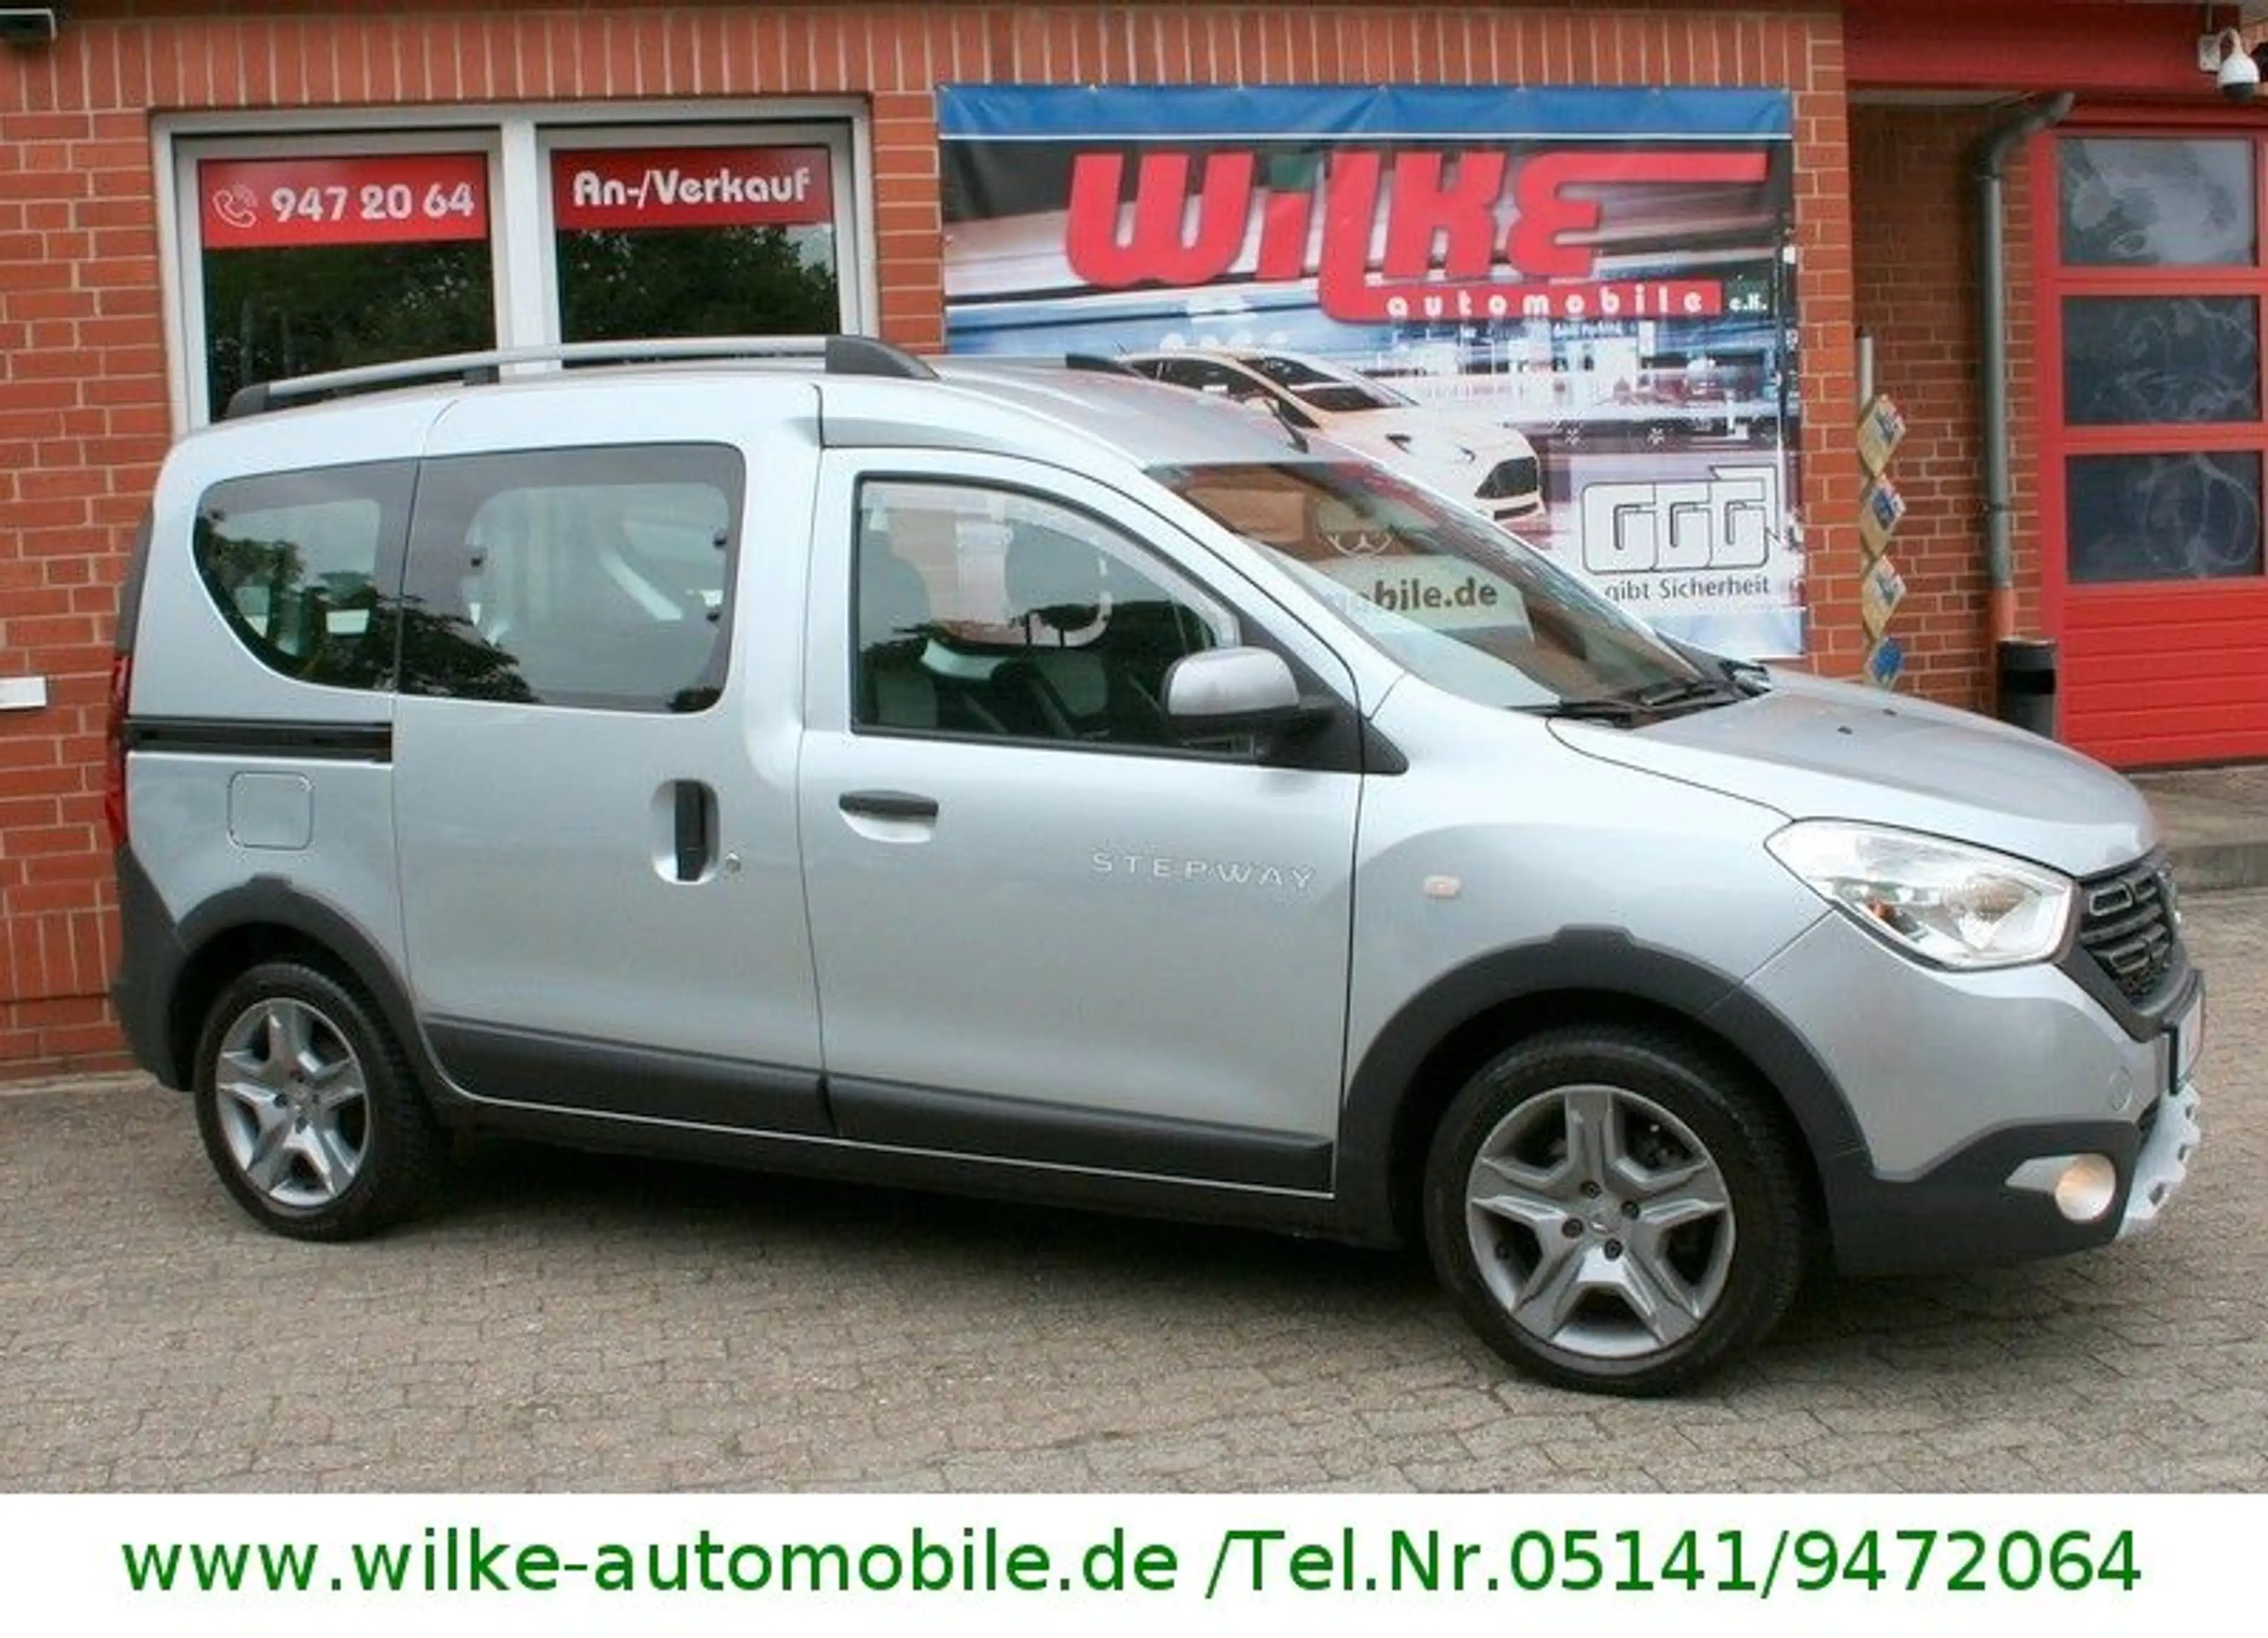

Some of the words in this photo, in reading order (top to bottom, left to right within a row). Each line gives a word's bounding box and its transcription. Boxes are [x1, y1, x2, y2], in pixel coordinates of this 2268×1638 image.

[272, 185, 347, 223] 947
[361, 185, 410, 219] 20
[424, 182, 475, 217] 64
[572, 167, 810, 210] An-/Verkauf
[1384, 285, 1706, 316] automobile
[1360, 575, 1498, 611] bile.de
[1658, 575, 1771, 600] Sicherheit
[1091, 850, 1315, 888] STEPWAY
